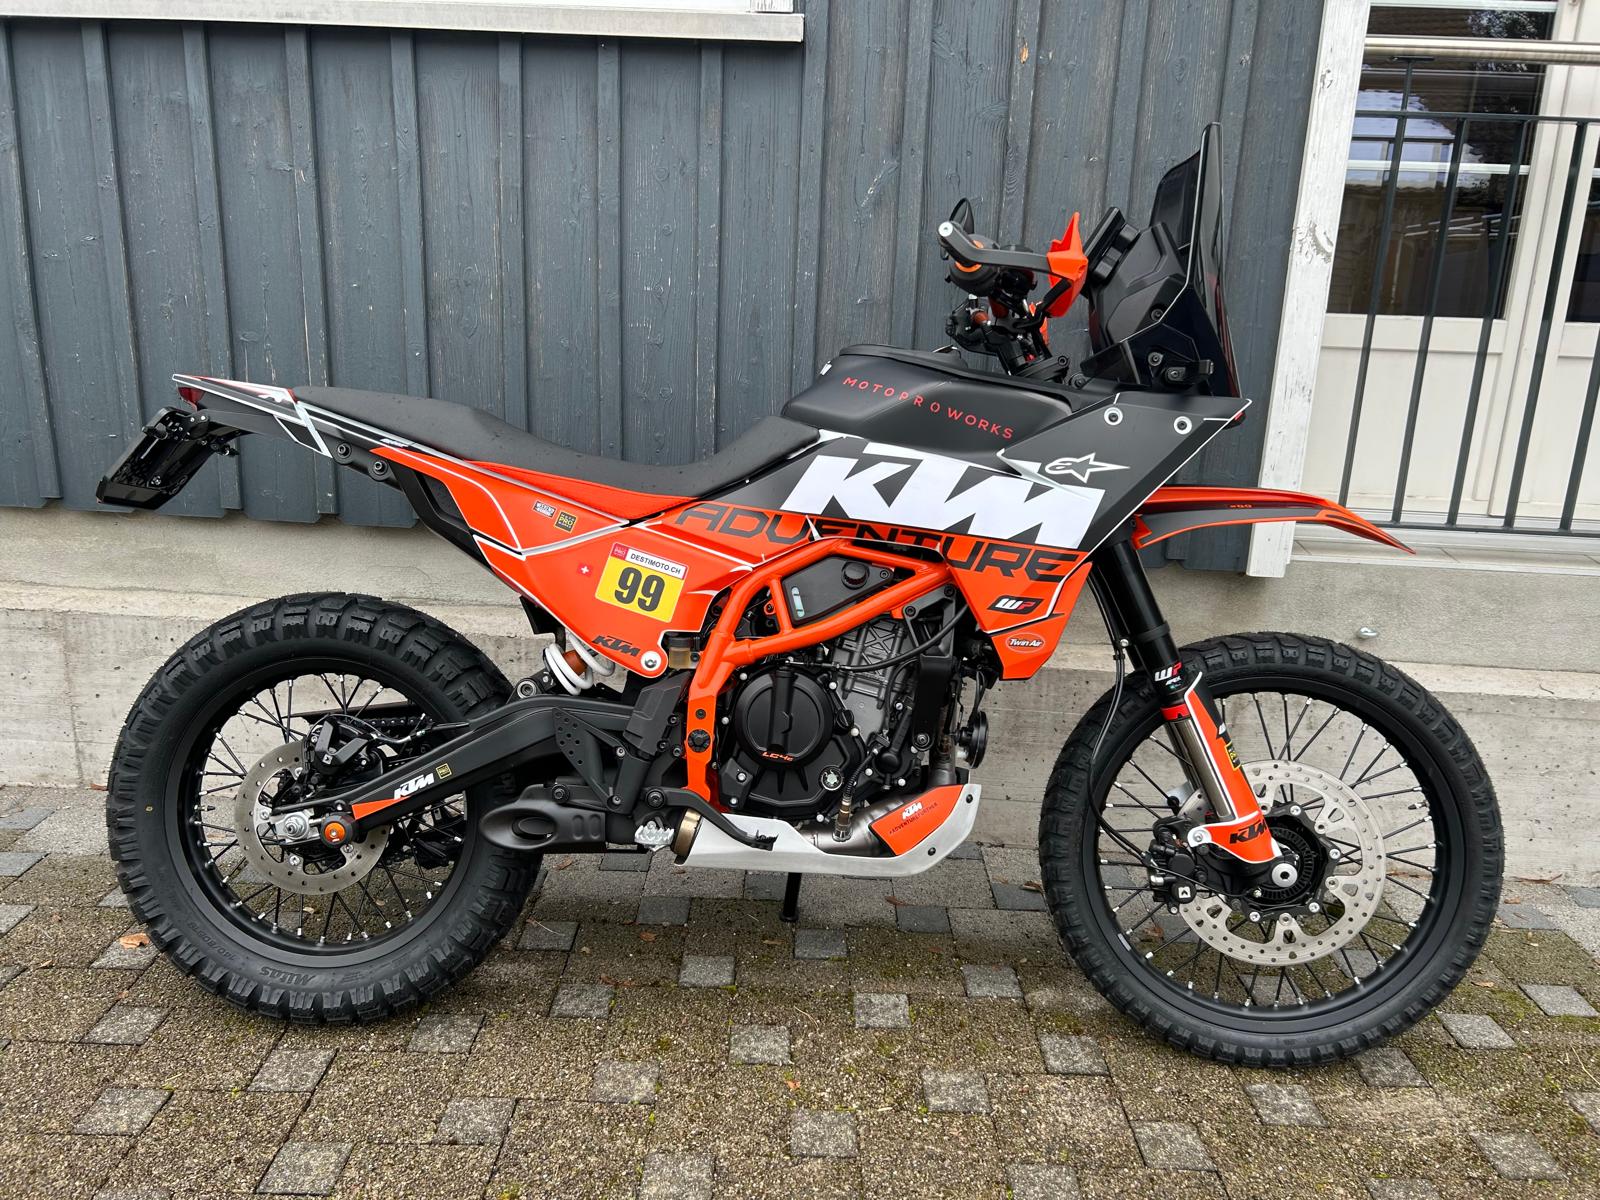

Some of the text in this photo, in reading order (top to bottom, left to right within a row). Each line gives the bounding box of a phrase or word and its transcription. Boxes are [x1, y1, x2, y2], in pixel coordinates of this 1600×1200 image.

[780, 442, 1105, 549] KTM
[675, 502, 1081, 583] ADVENTURE
[630, 553, 682, 575] DESTIMOTO.CH
[614, 566, 665, 612] 99
[994, 598, 1036, 610] WP
[592, 635, 641, 657] KTM
[1010, 638, 1042, 647] Twin Air
[1155, 661, 1182, 682] WP
[394, 772, 435, 800] KTM
[902, 801, 923, 820] KTM
[1229, 819, 1267, 845] KTM
[260, 966, 316, 986] Mitas
